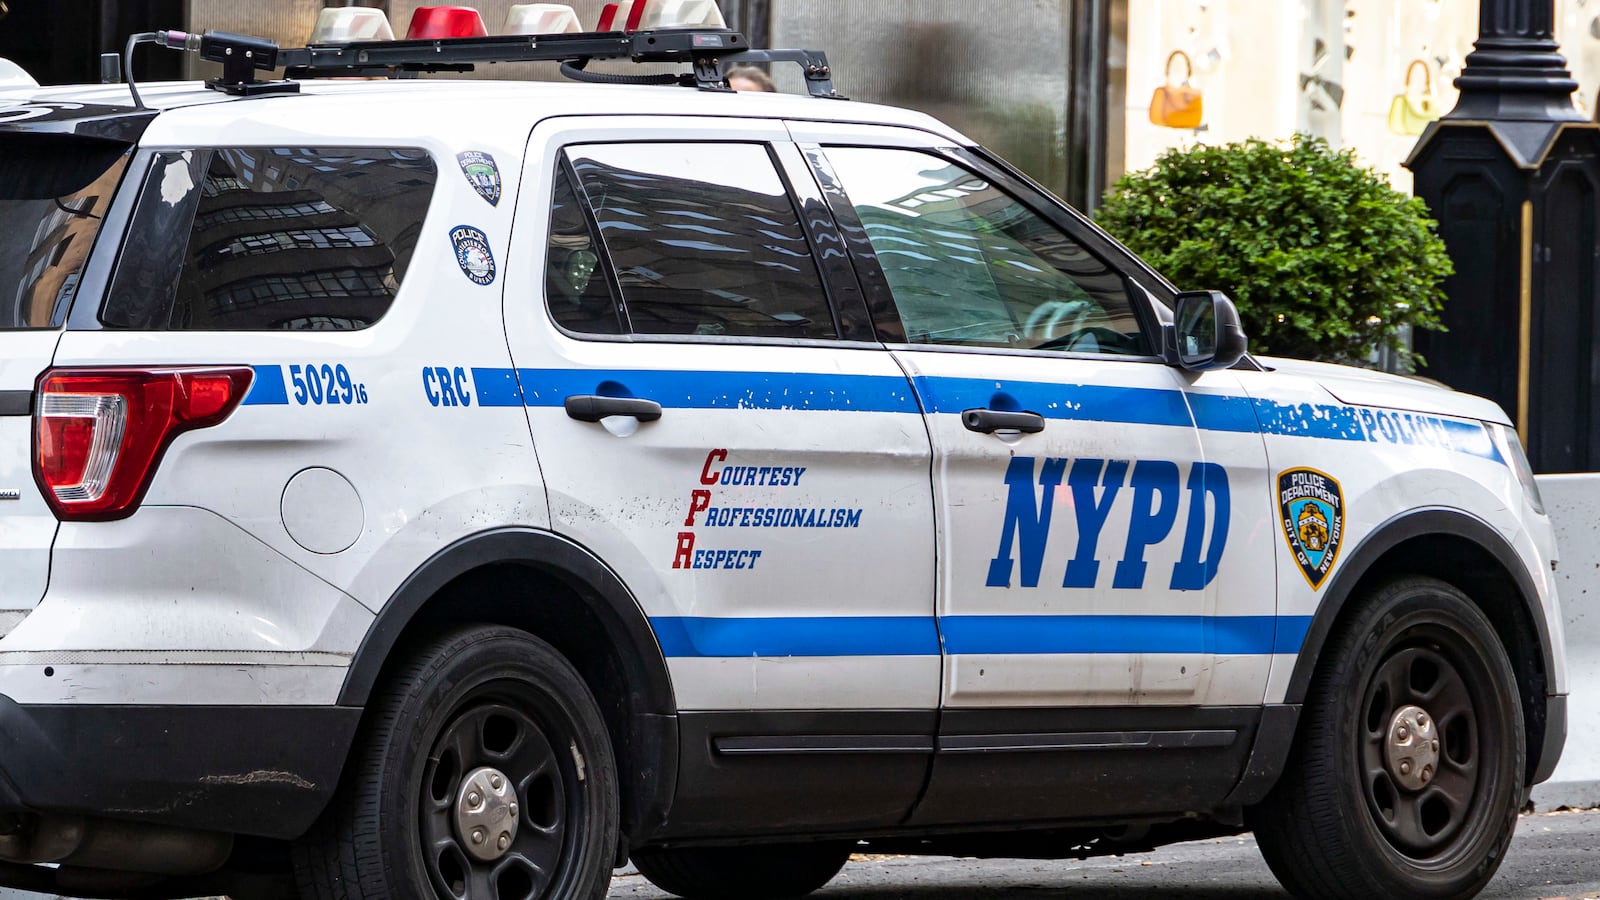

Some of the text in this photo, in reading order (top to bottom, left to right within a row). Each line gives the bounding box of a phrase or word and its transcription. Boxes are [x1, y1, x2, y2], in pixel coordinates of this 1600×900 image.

[452, 229, 487, 248] POLICE
[289, 363, 353, 406] 5029
[422, 366, 471, 407] CRC
[1359, 407, 1451, 450] POLICE
[700, 449, 806, 486] COURTESY
[1291, 473, 1326, 489] POLICE
[684, 489, 863, 527] PROFESSIONALISM
[1281, 485, 1340, 508] DEPARTMENT
[985, 456, 1231, 591] NYPD
[672, 532, 762, 569] RESPECT
[1284, 515, 1342, 574] CITY OF NEW YORK
